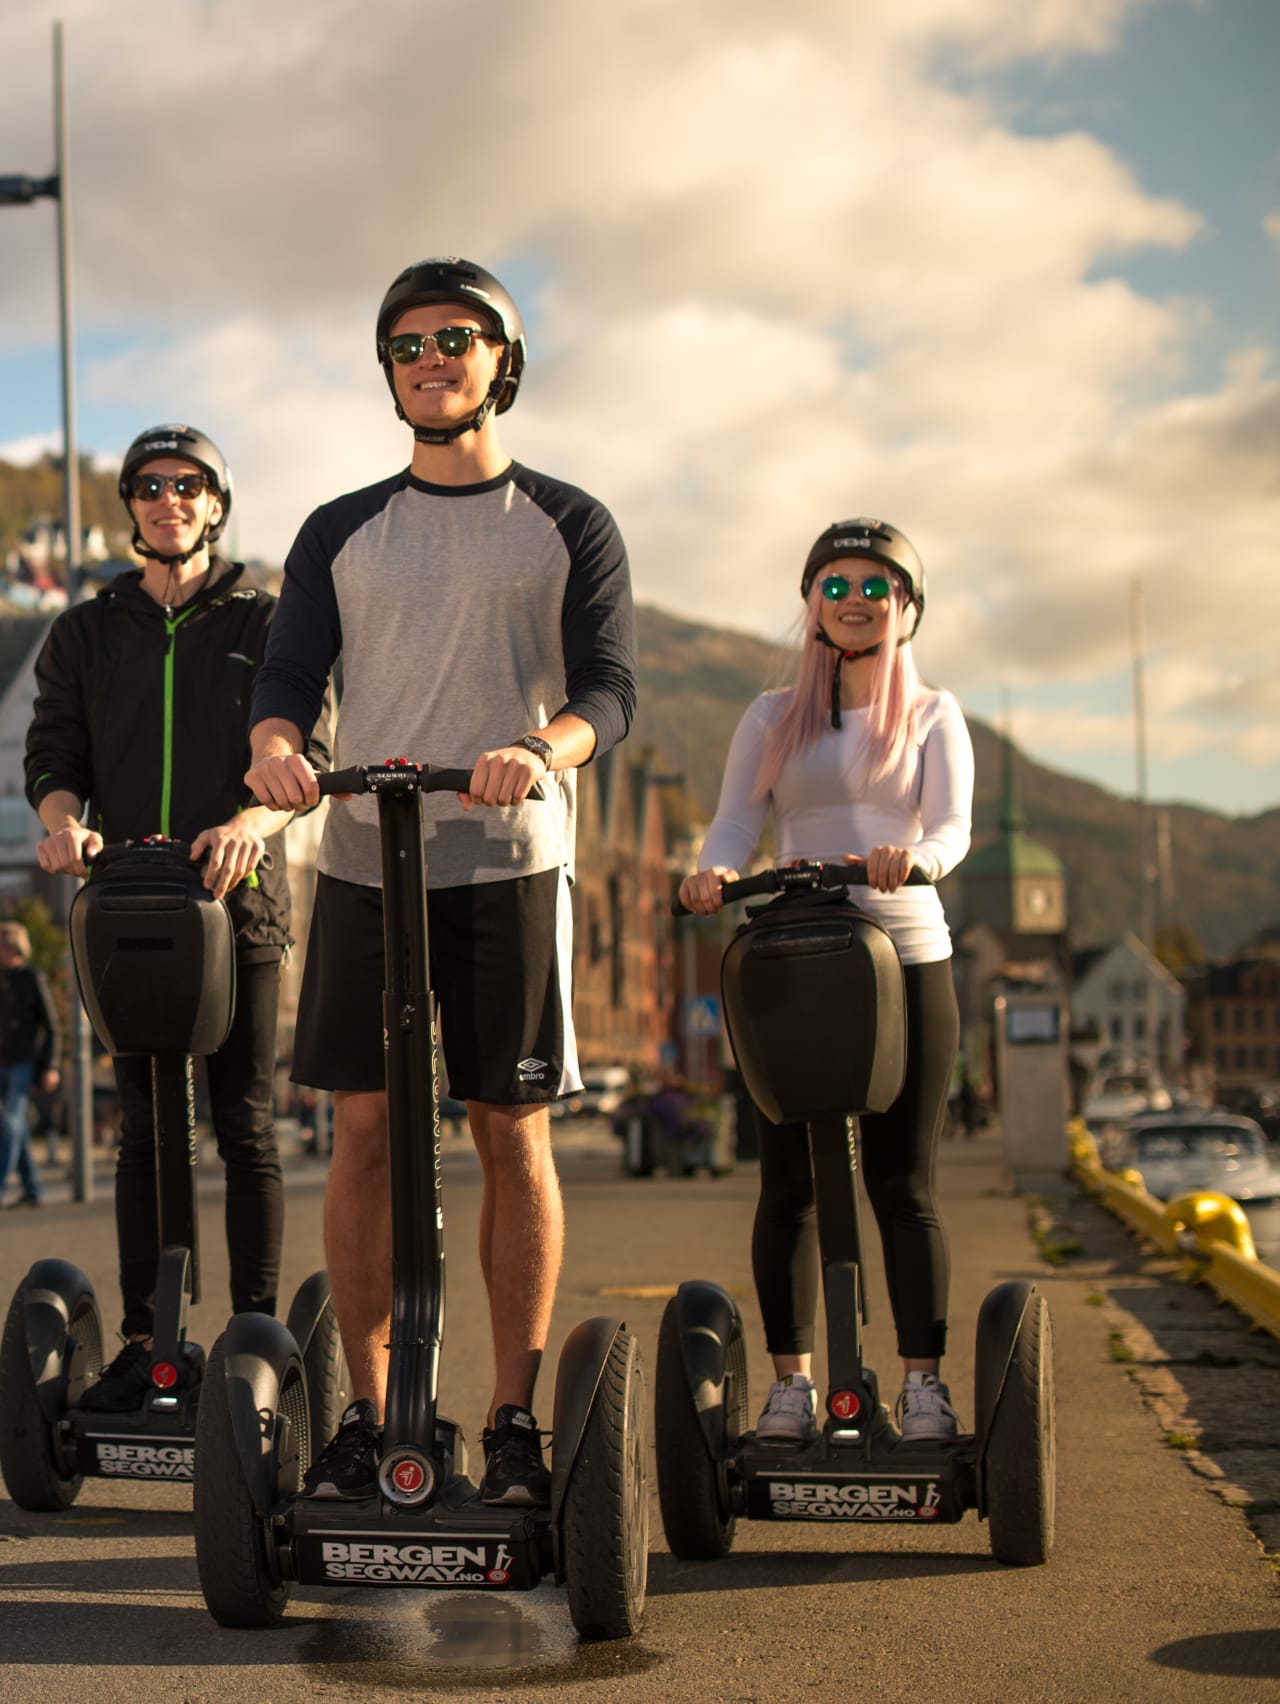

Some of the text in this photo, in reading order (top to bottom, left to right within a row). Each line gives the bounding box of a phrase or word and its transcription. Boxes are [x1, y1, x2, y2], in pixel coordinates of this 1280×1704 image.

[519, 1072, 545, 1081] umbro
[96, 1443, 194, 1465] BERGE
[100, 1460, 194, 1476] SEGWA
[769, 1482, 918, 1504] BERGEN
[322, 1542, 487, 1567] BERGEN
